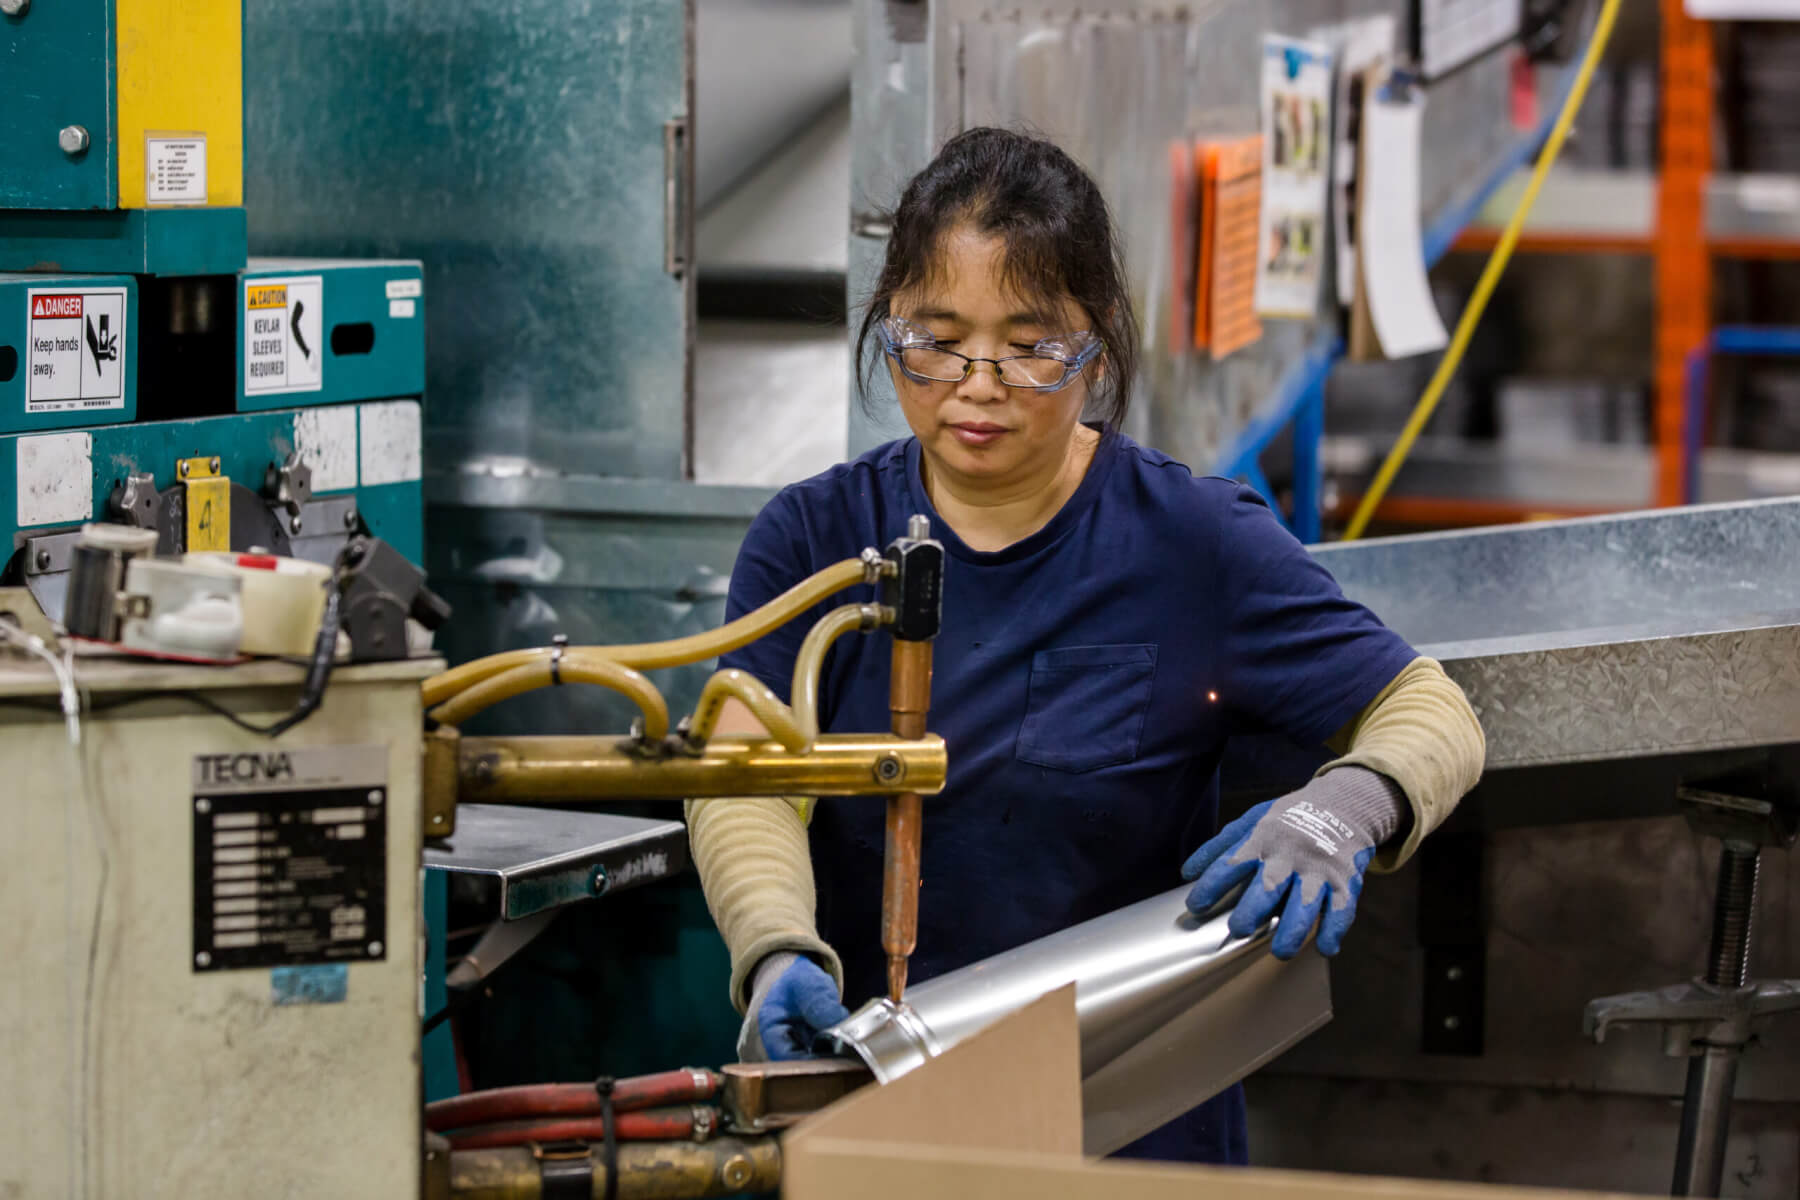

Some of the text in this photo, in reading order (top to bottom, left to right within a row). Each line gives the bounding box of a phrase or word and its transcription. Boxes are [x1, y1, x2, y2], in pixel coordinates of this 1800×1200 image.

[258, 290, 286, 306] CAUTION
[45, 298, 81, 316] DANGER
[254, 318, 280, 334] KEVLAR
[34, 336, 79, 356] Keep hands
[252, 340, 282, 356] SLEEVES
[33, 363, 56, 379] away.
[250, 361, 284, 378] REQUIRED
[196, 753, 294, 782] TECNA
